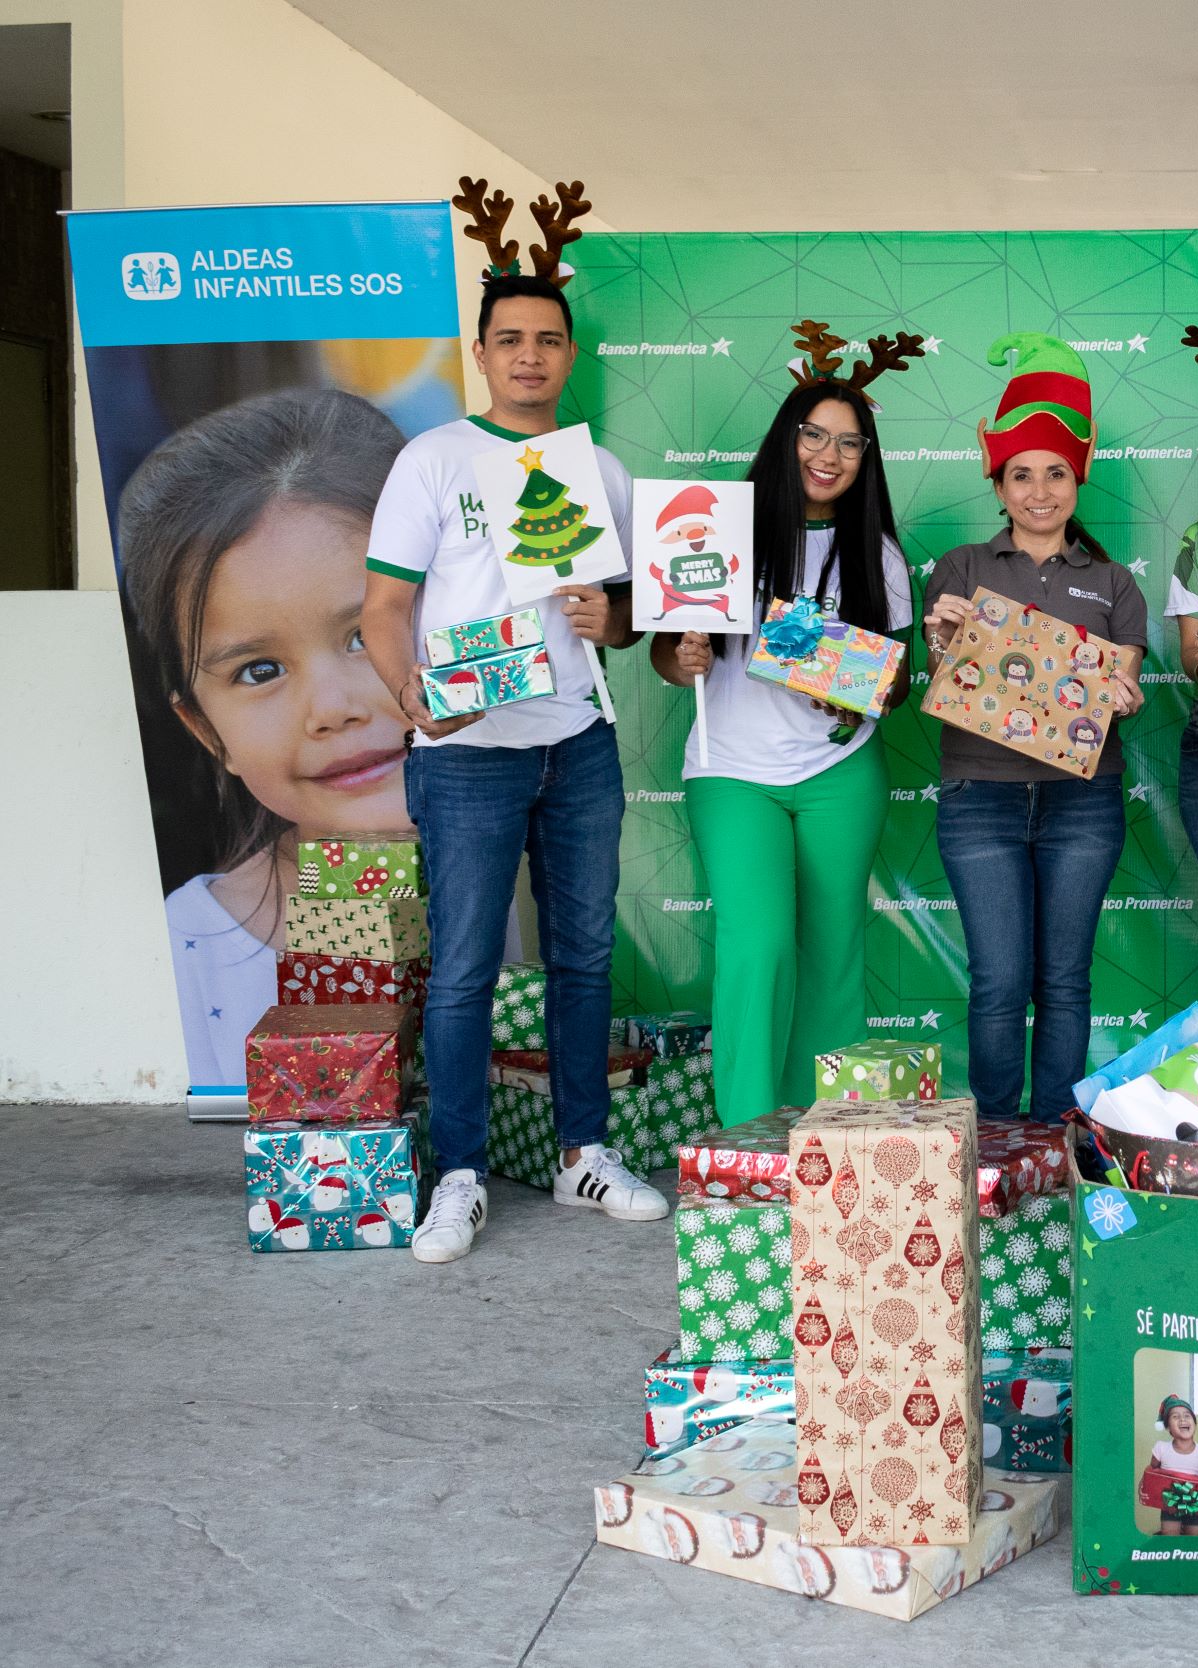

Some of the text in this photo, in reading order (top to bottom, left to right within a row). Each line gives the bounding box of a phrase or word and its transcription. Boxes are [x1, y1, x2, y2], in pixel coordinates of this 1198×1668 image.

[191, 247, 293, 271] ALDEAS
[194, 272, 403, 299] INFANTILES SOS
[597, 341, 707, 355] Banco Promerica
[665, 448, 757, 462] Banco Promer
[1092, 446, 1192, 460] anco Promerica
[680, 559, 714, 570] MERRY
[676, 567, 721, 585] XMAS
[636, 789, 686, 802] Promer
[663, 898, 703, 911] Banco
[873, 897, 958, 911] Banco Prome
[1124, 897, 1193, 910] Promerica
[1136, 1306, 1154, 1335] SÉ
[1131, 1549, 1171, 1561] Banco
